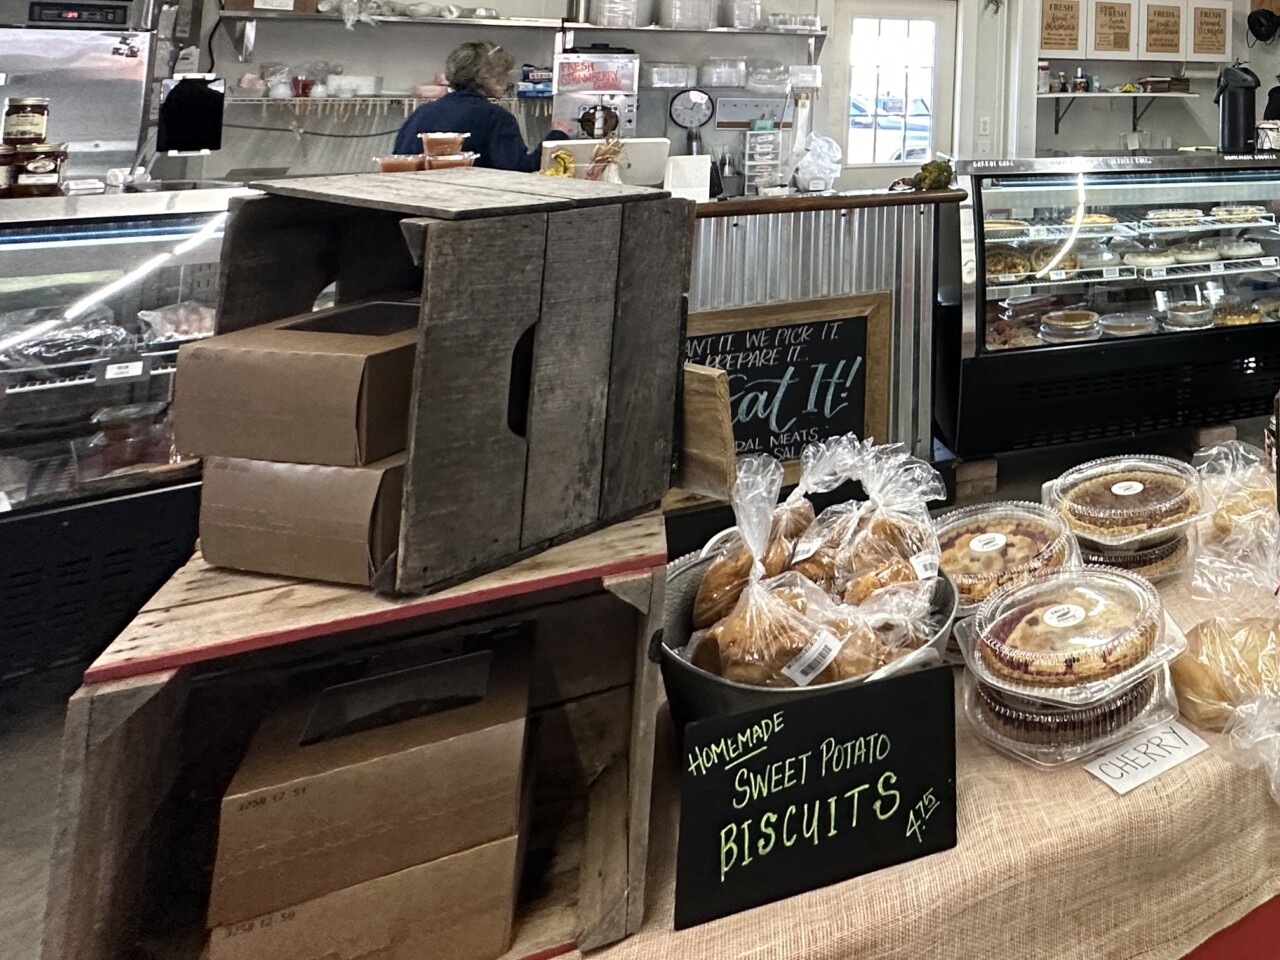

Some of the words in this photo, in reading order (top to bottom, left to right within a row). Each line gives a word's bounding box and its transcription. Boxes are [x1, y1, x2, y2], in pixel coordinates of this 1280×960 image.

[1049, 3, 1074, 12] FRESH
[1153, 10, 1175, 18] FRESH
[1200, 11, 1222, 19] FRESH
[685, 338, 717, 357] ANT
[718, 333, 736, 353] IT.
[745, 328, 771, 348] WE
[775, 325, 814, 347] PICK
[821, 321, 844, 341] IT.
[705, 347, 782, 370] PREPARE
[735, 440, 764, 453] RAL
[688, 711, 785, 776] HOMEMADE
[1099, 726, 1189, 780] CHERRY
[733, 751, 812, 810] SWEET
[820, 733, 891, 777] POTATO
[720, 771, 900, 883] BISCUITS
